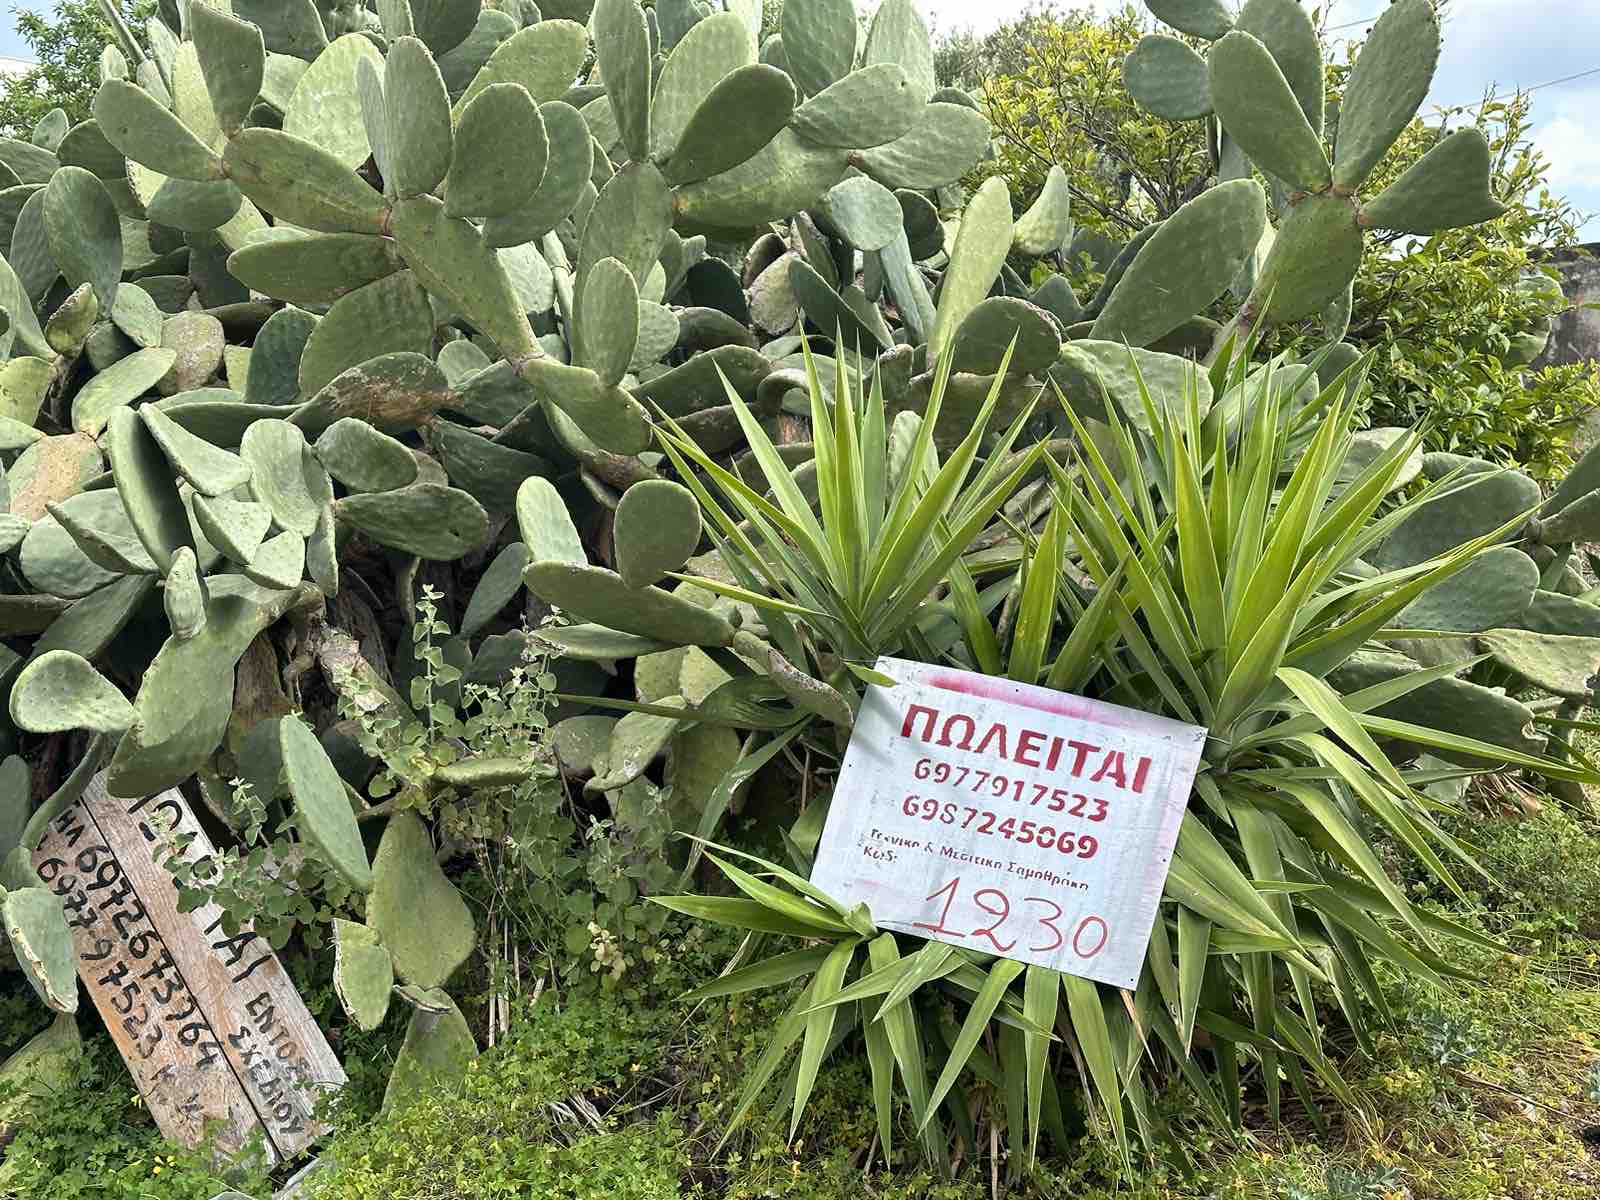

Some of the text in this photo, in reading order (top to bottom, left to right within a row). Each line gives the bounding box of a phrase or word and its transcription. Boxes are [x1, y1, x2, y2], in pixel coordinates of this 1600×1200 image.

[901, 704, 1152, 794] ΠΩΛΕΙΤΑΙ
[902, 794, 1100, 860] 6987245069
[914, 758, 1110, 823] 6977917523
[912, 876, 1109, 959] 1230
